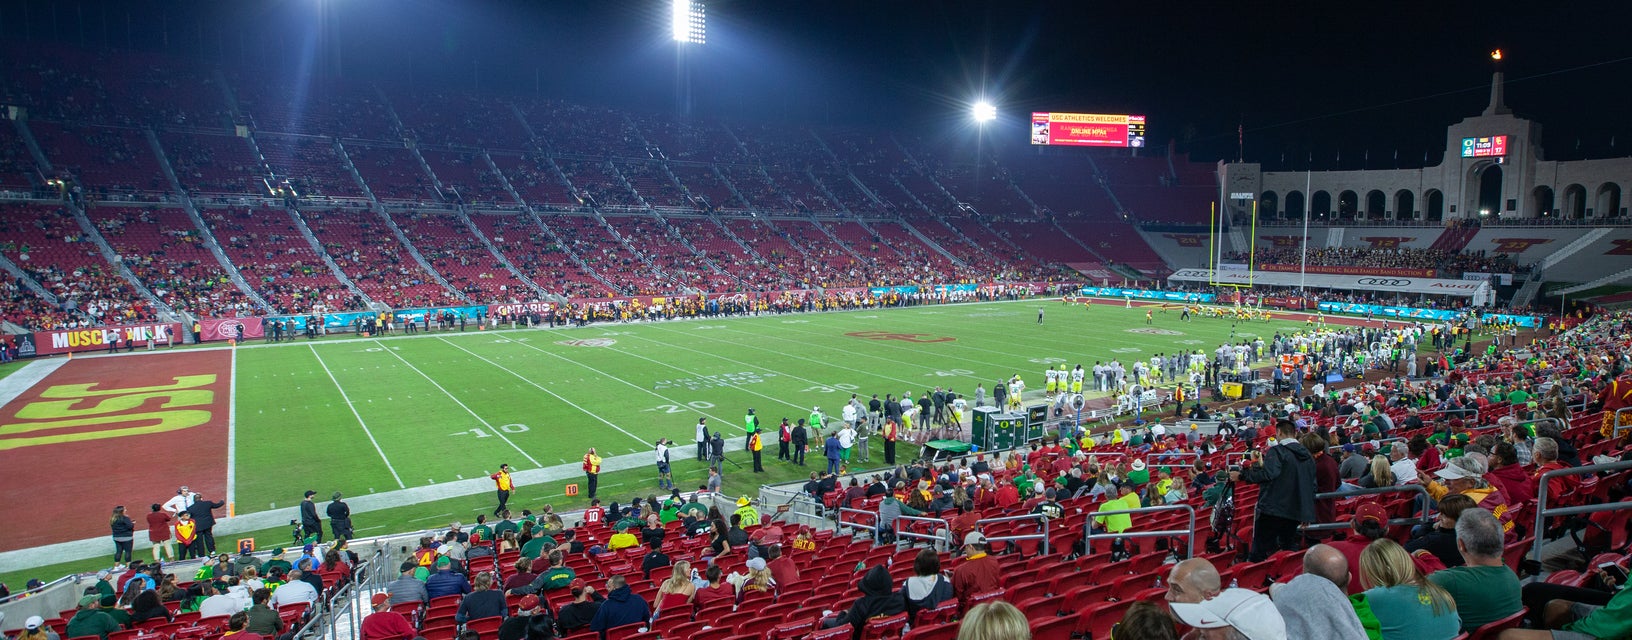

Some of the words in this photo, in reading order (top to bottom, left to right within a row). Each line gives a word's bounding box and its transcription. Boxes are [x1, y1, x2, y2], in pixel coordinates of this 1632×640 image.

[125, 324, 168, 342] MIK
[467, 423, 531, 439] 10
[567, 485, 577, 494] 10
[588, 511, 599, 522] 10
[419, 552, 432, 566] 4
